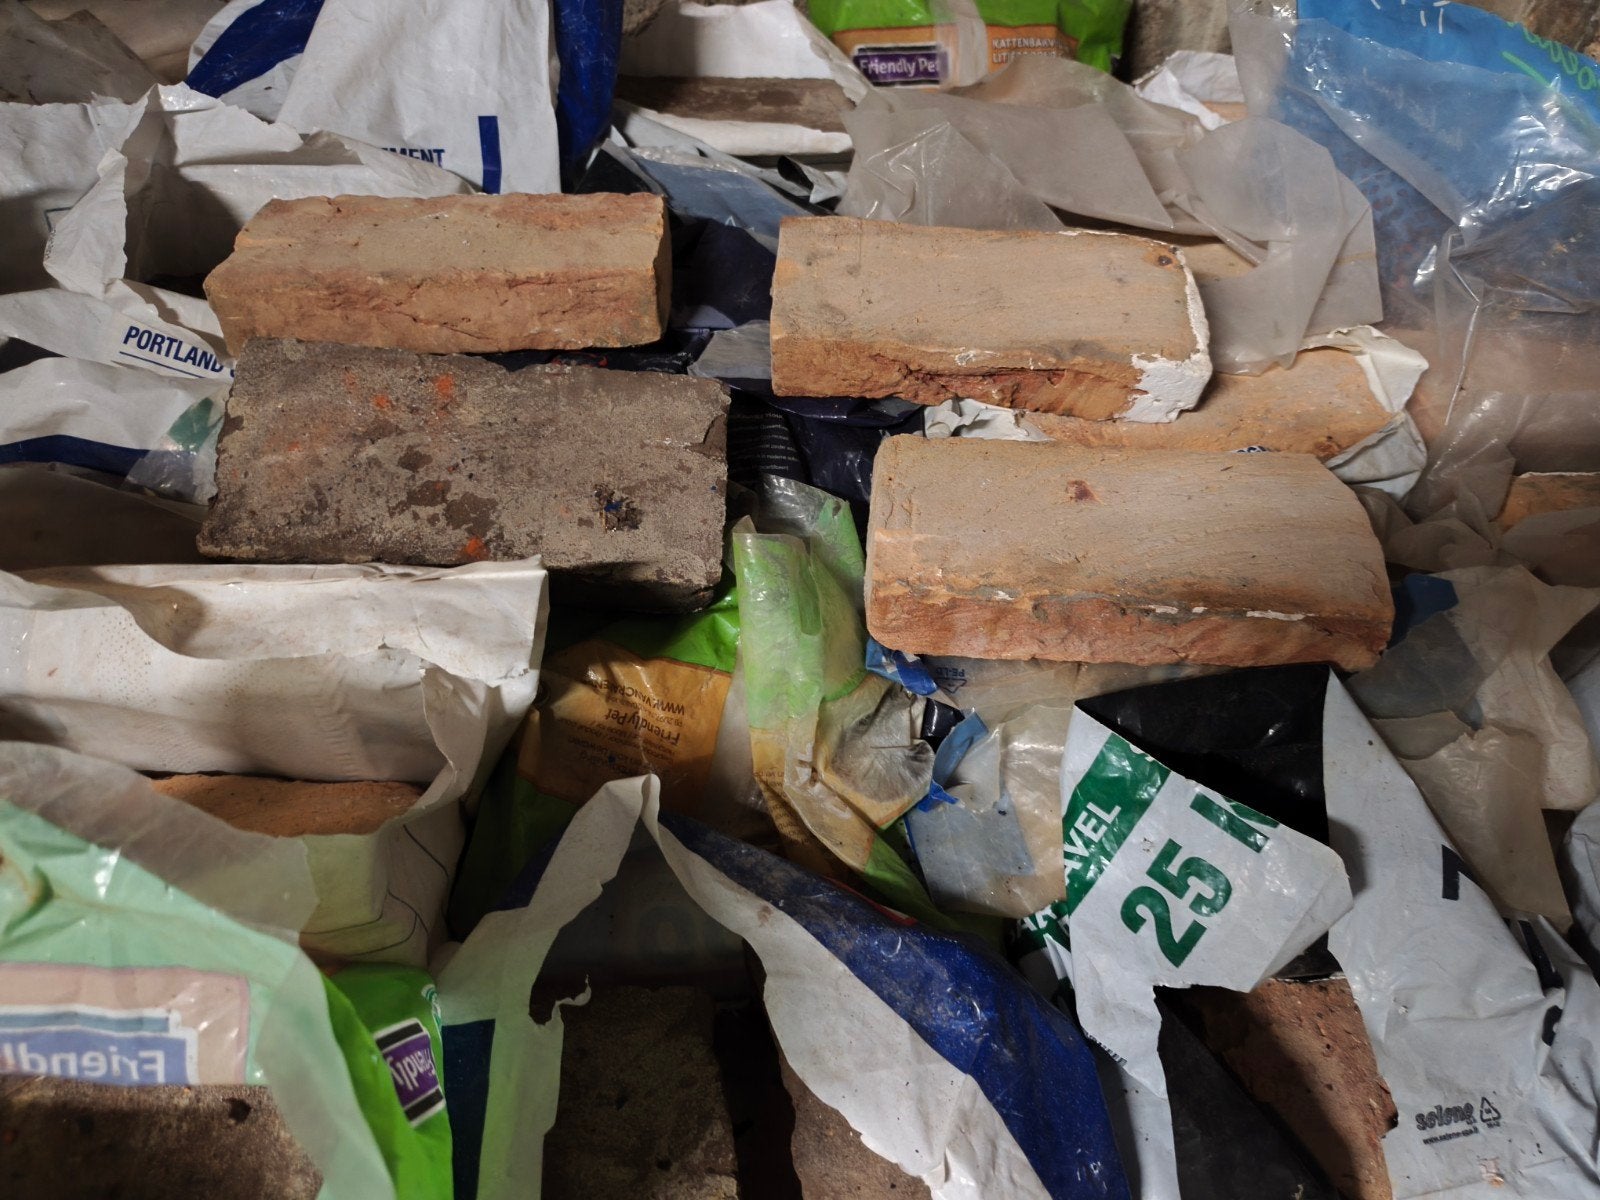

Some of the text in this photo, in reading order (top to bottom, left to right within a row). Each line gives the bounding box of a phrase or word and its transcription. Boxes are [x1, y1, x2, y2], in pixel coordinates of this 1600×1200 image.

[860, 57, 916, 78] Friendly
[604, 708, 629, 727] Pet
[628, 711, 681, 746] Friendly
[1120, 838, 1233, 969] 25
